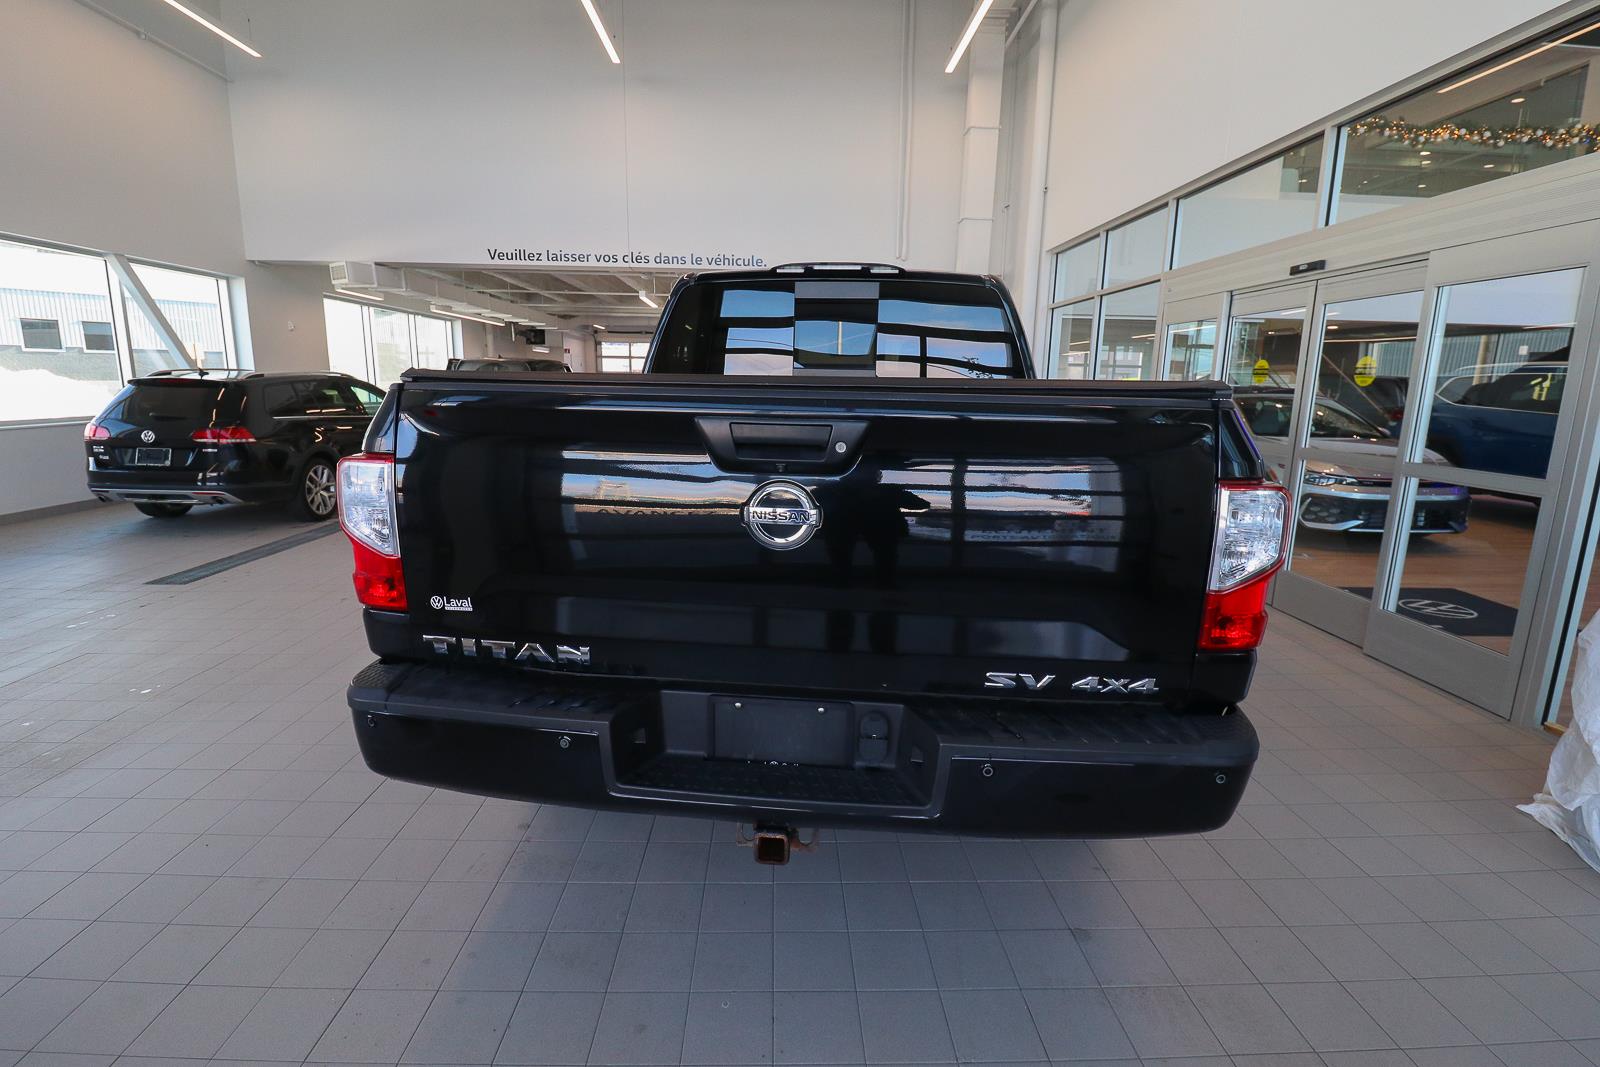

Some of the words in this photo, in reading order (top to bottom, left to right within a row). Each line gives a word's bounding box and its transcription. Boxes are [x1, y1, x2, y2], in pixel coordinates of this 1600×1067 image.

[487, 248, 543, 261] Veuillez
[546, 249, 592, 263] laisser
[595, 253, 618, 264] vos
[622, 251, 650, 264] clés
[653, 251, 687, 265] dans
[691, 253, 703, 266] le
[706, 253, 768, 267] véhicule.
[752, 510, 810, 523] NISSAN
[444, 596, 472, 608] Laval
[422, 634, 591, 665] TITAN
[984, 671, 1056, 690] SV
